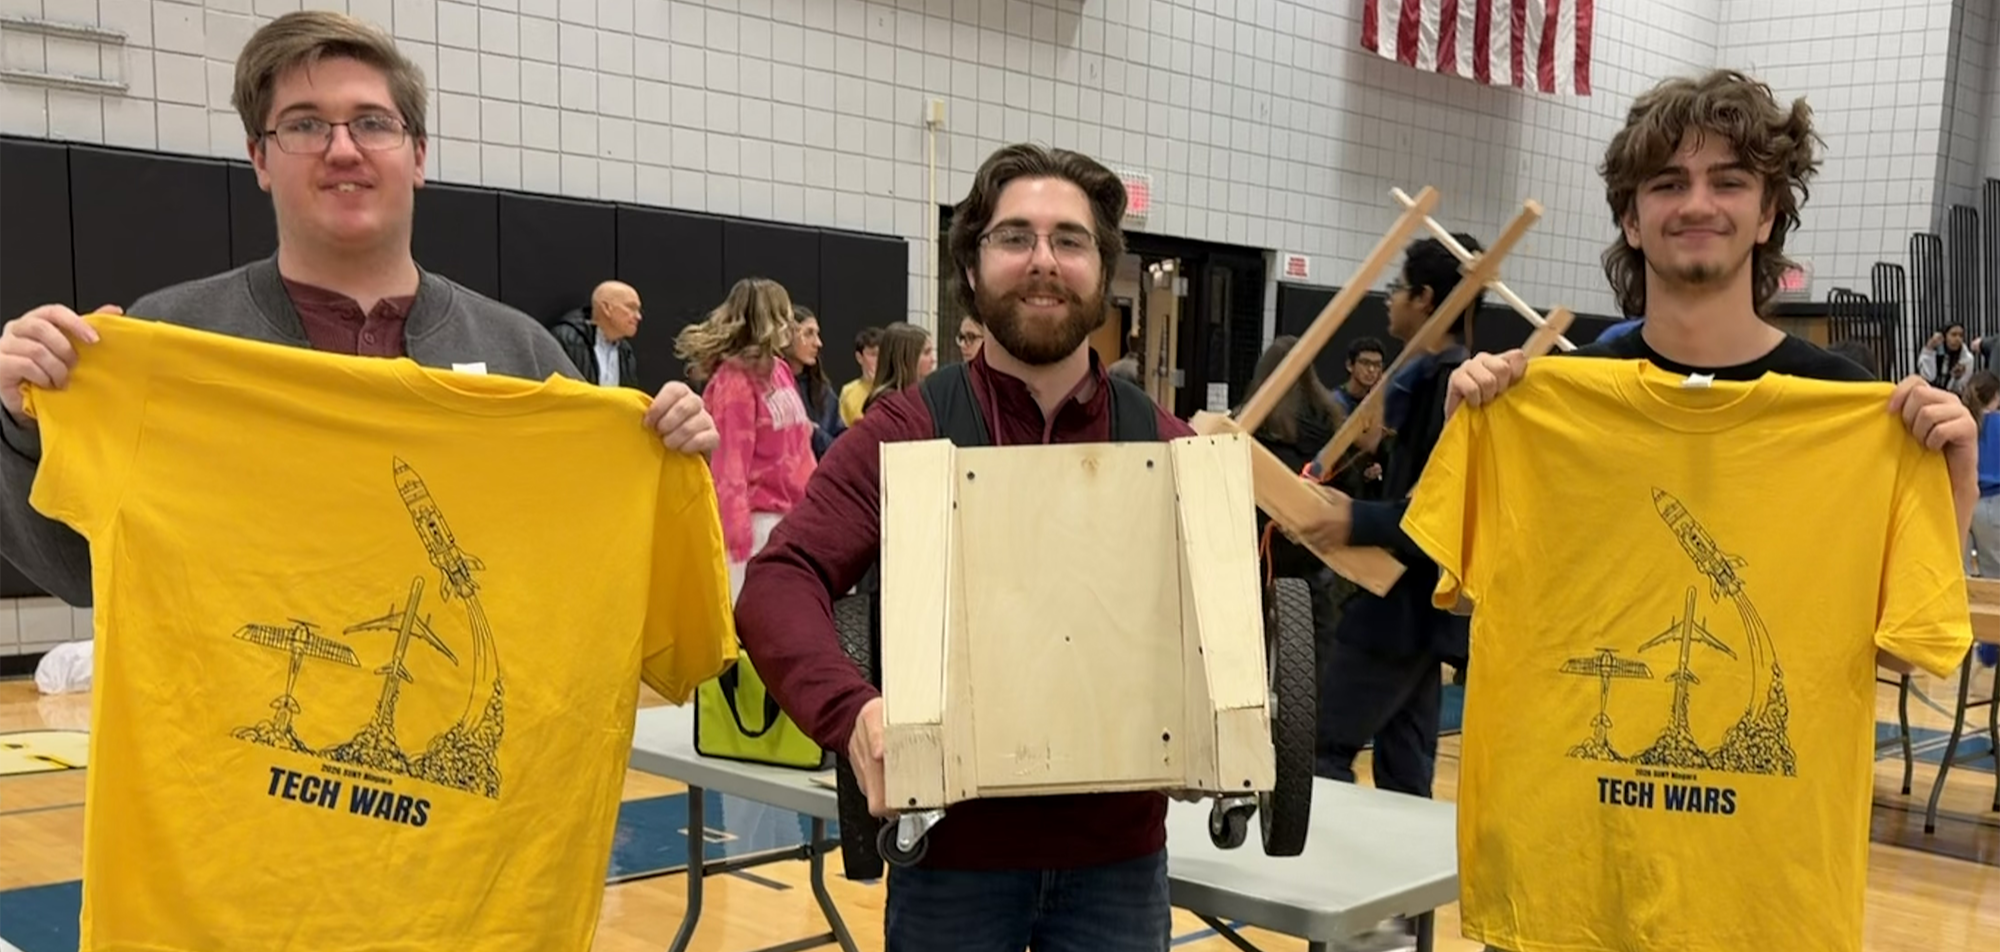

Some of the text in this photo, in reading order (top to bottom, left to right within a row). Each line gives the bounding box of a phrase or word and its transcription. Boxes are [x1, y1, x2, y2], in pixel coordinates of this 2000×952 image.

[268, 767, 431, 827] TECH WARS
[1597, 777, 1737, 815] TECH WARS
